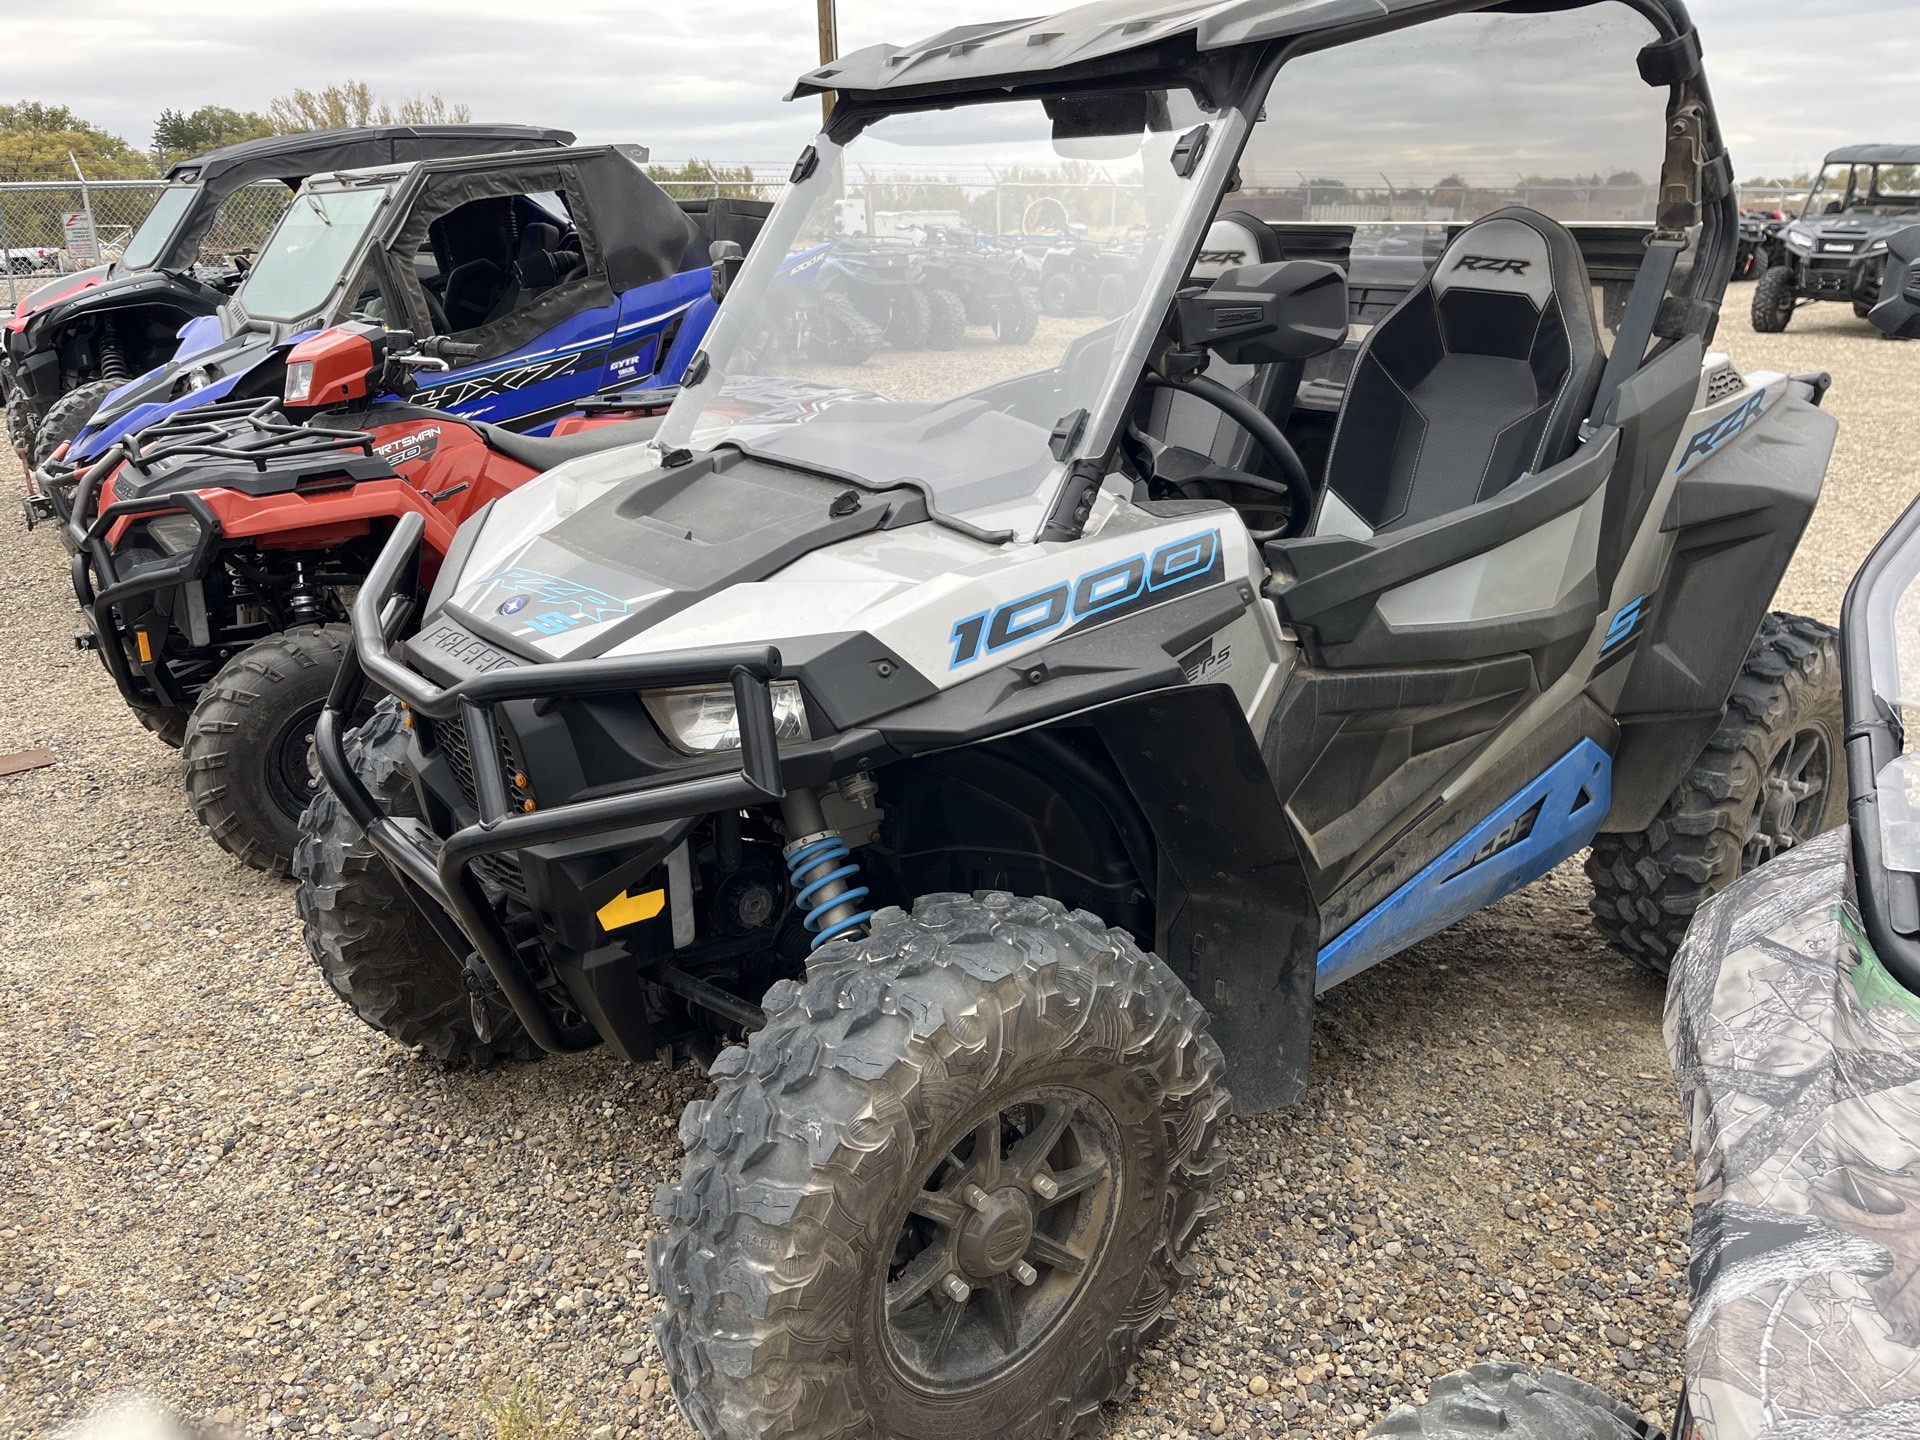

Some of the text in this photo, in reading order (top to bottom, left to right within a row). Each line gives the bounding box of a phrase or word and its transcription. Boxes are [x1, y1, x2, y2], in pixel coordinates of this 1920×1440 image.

[1451, 255, 1531, 275] RZR
[610, 356, 640, 370] GYTR
[1673, 388, 1766, 477] RZR
[476, 567, 628, 623] RZR
[949, 528, 1217, 670] 1000
[1187, 645, 1231, 682] EPS
